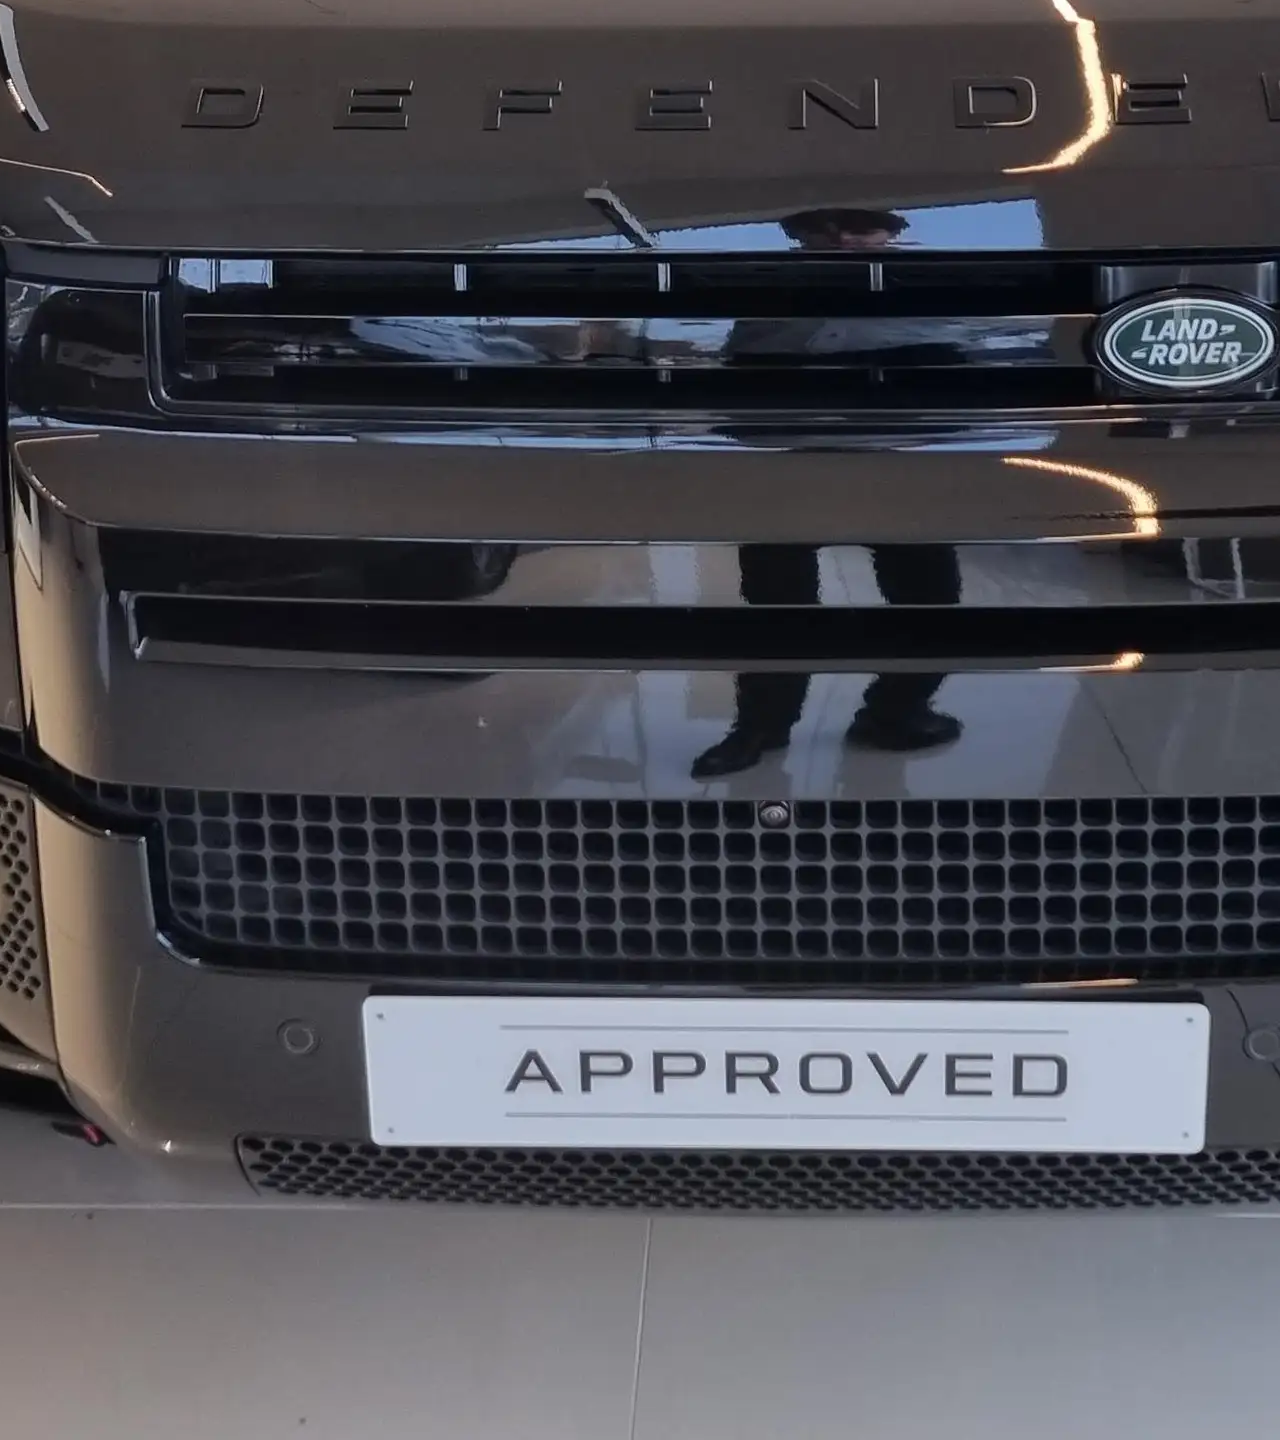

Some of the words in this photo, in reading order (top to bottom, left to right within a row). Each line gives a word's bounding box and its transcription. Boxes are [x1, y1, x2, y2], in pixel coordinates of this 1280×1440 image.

[1140, 317, 1218, 343] LAND
[1147, 341, 1243, 366] ROVER
[504, 1047, 1070, 1100] APPROVED
